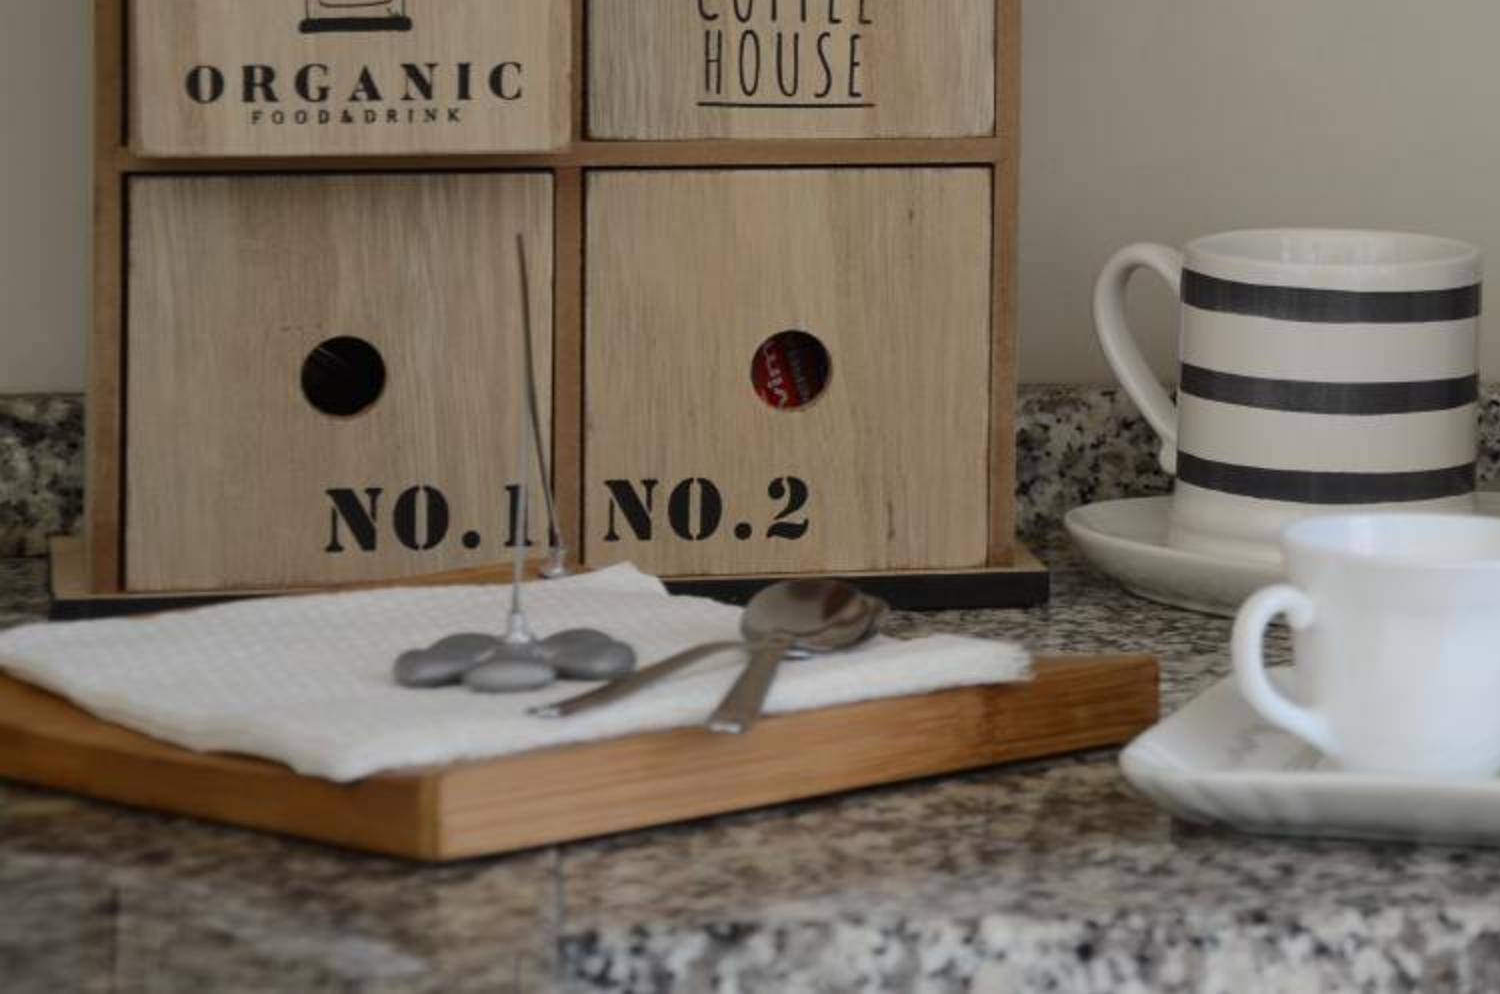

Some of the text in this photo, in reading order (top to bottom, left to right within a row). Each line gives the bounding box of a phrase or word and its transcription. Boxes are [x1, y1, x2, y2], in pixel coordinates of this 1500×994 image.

[185, 61, 524, 105] ORGANIC
[704, 28, 863, 99] HOUSE
[251, 108, 463, 126] FOOD&DRINK
[325, 484, 536, 554] NO.1
[604, 476, 811, 543] NO.2
